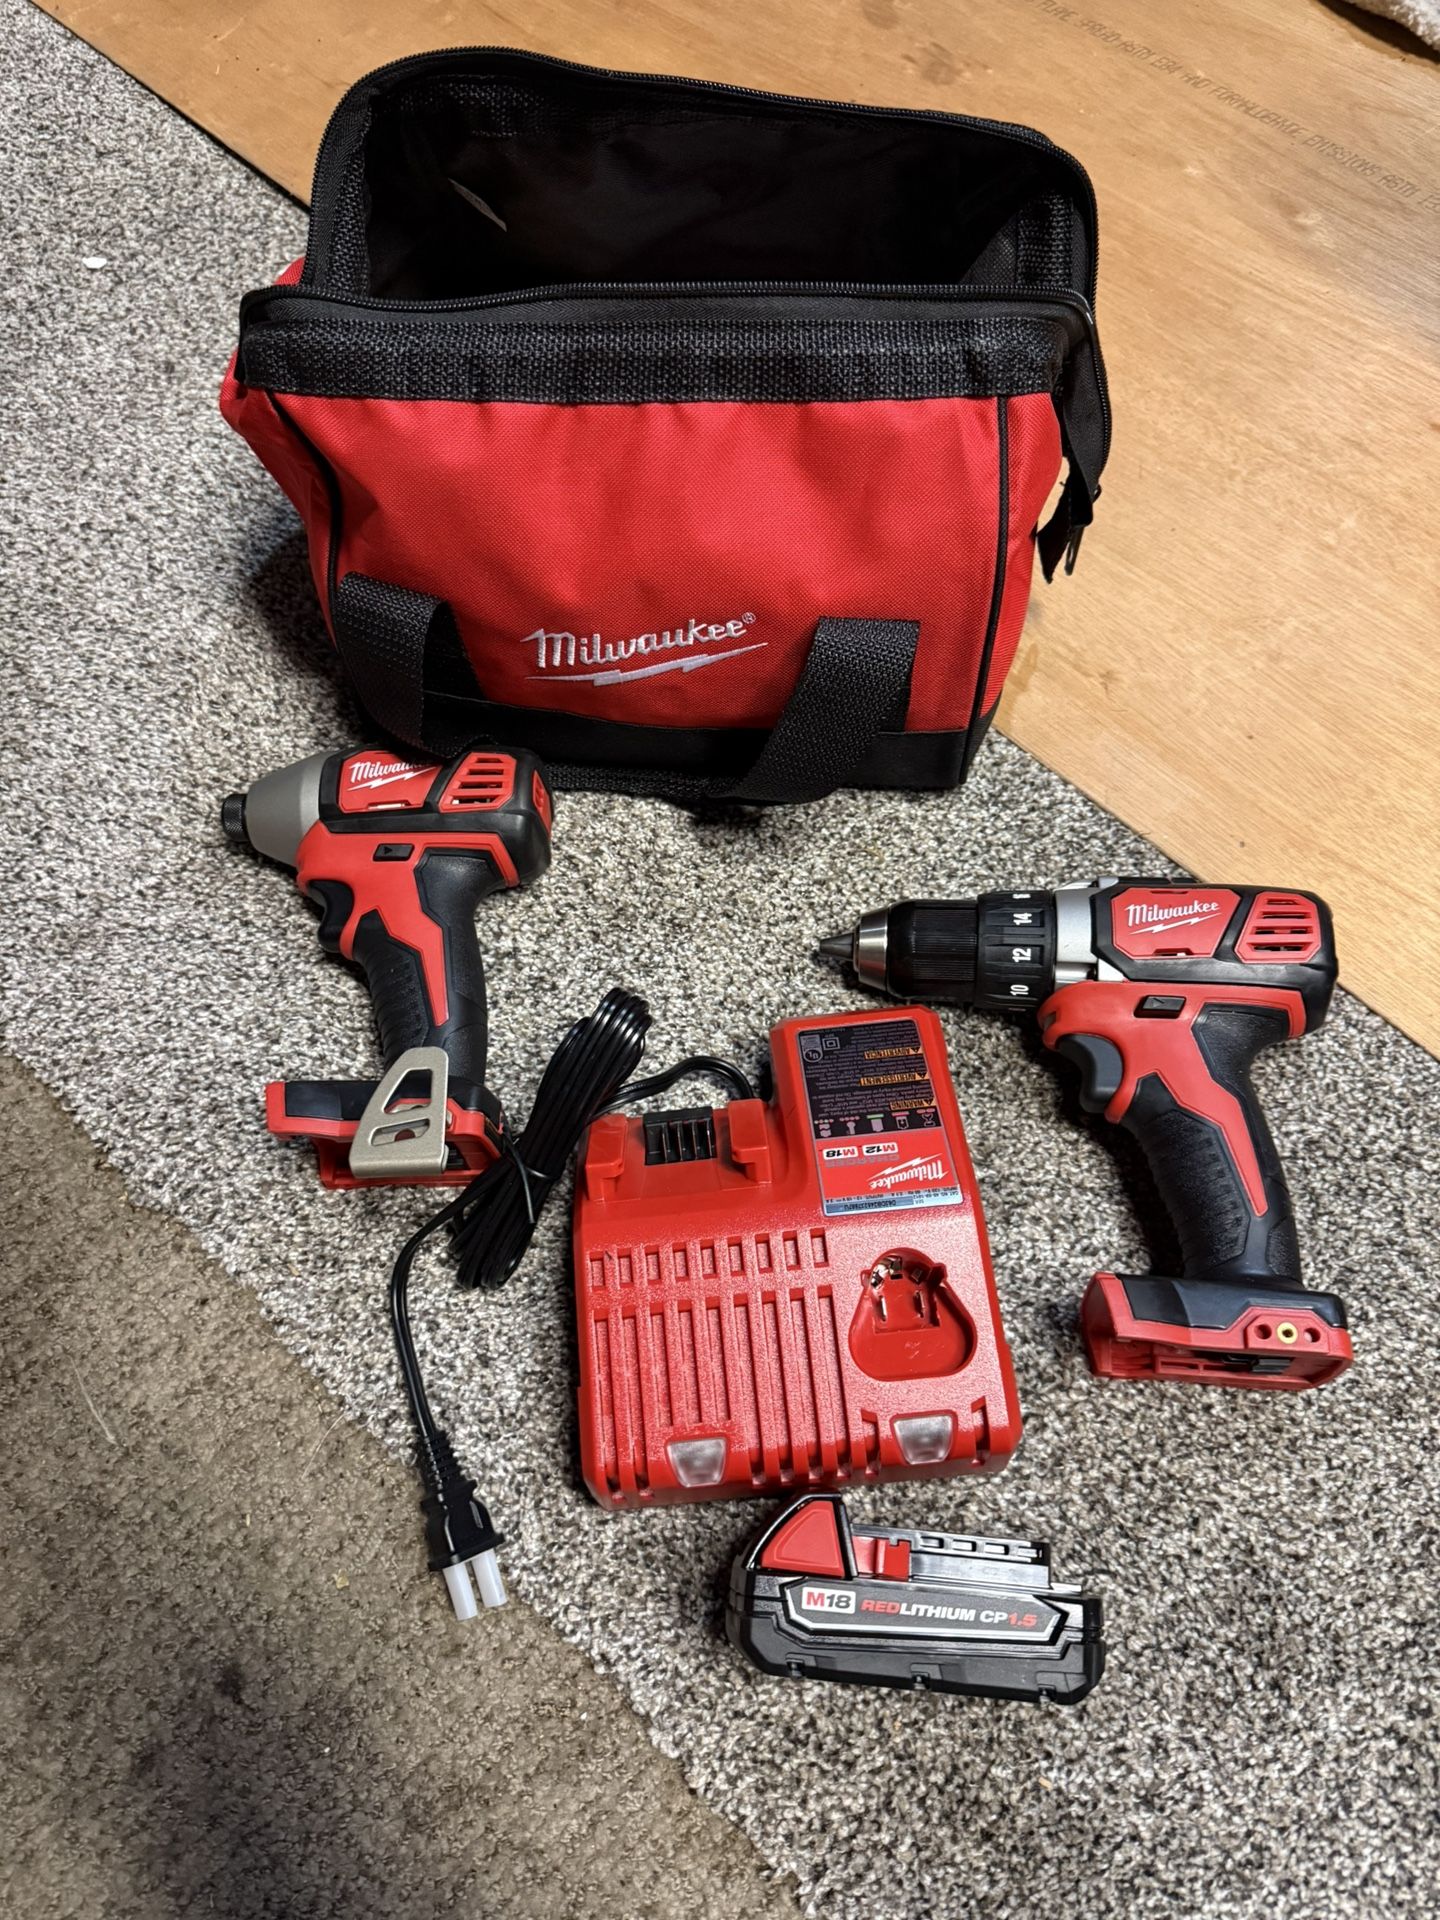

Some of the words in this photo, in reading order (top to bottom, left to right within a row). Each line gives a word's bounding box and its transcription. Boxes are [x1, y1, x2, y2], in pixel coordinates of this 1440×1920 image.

[1012, 912, 1032, 926] 14
[1123, 900, 1220, 927] Milwaukee
[1012, 948, 1031, 963] 12
[1009, 984, 1030, 996] 10
[825, 1148, 856, 1158] M18
[865, 1144, 896, 1154] M12
[870, 1159, 949, 1190] Milwaukee
[805, 1591, 852, 1610] M18
[860, 1599, 976, 1623] REDLITHIUM
[979, 1609, 1038, 1628] CP1.5
